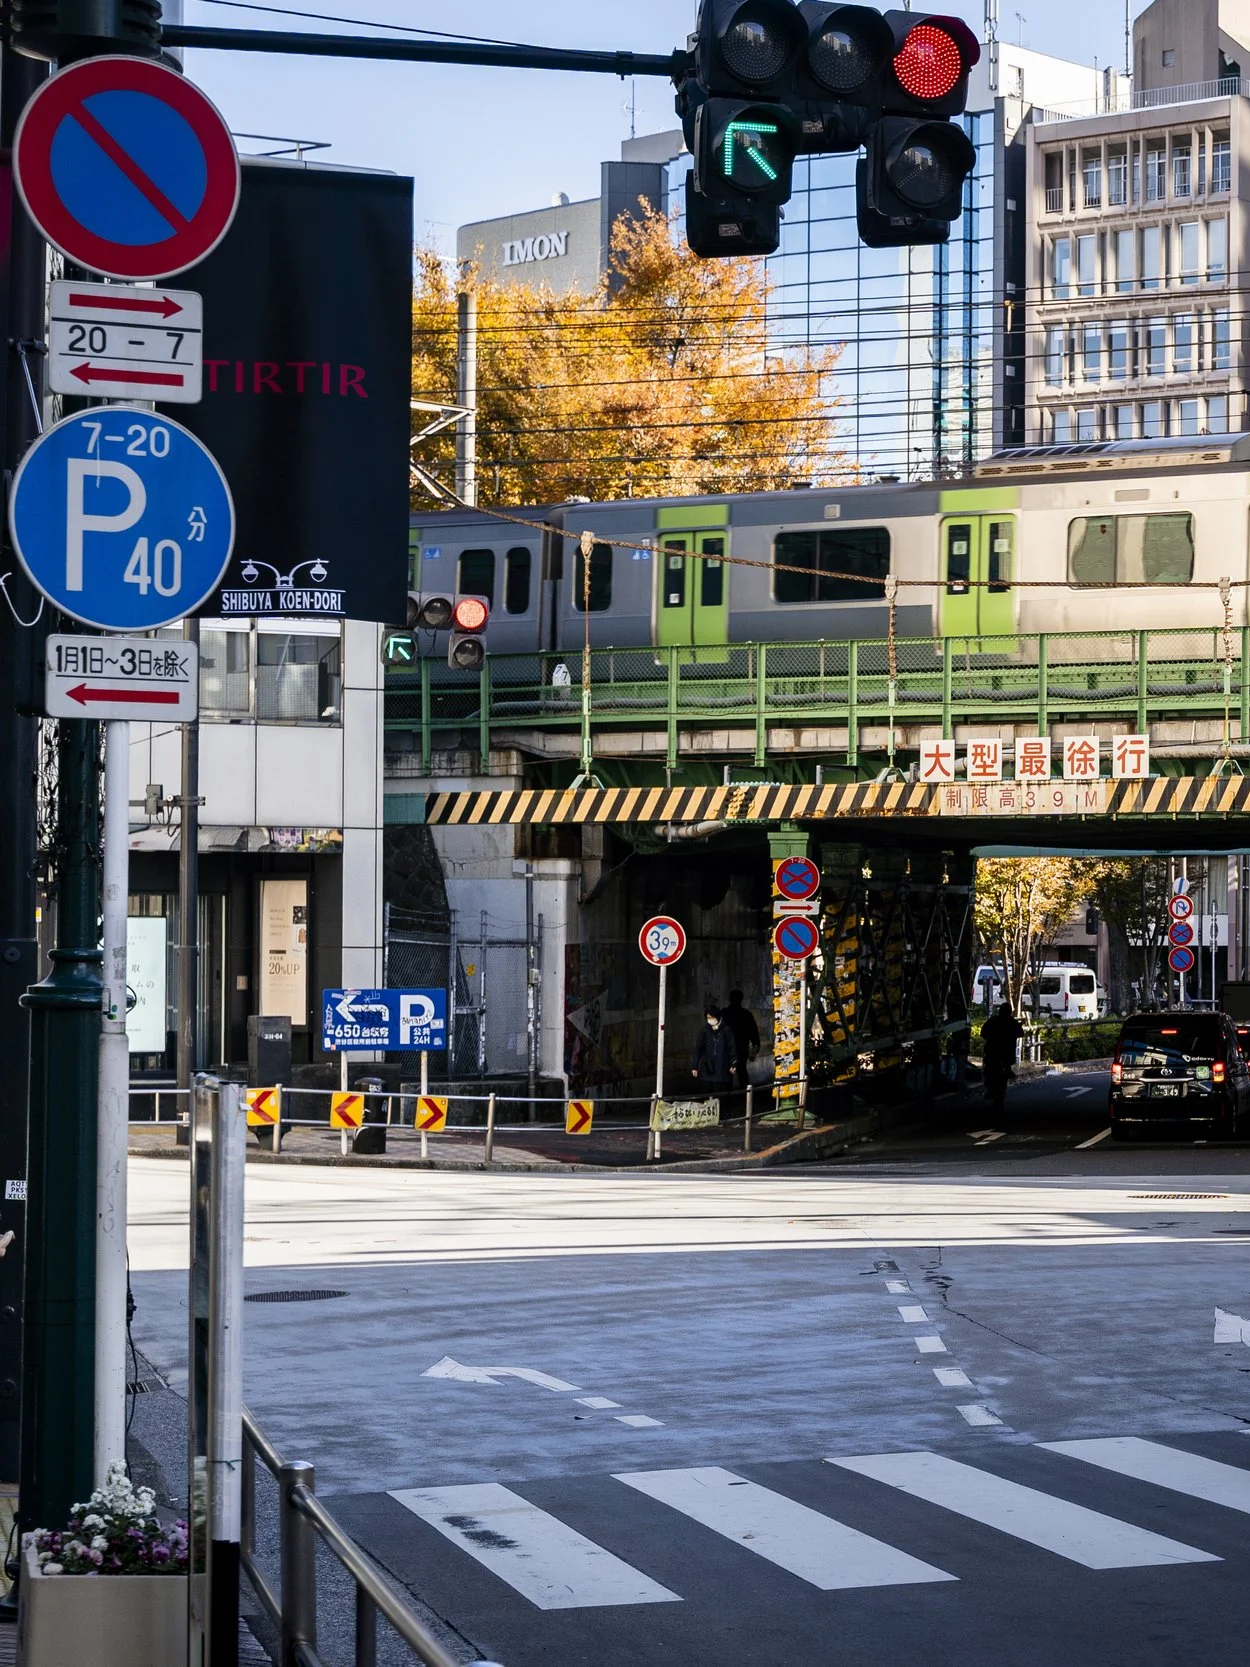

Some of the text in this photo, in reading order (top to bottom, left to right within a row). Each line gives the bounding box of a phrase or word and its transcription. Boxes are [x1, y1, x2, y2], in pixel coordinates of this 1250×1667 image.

[502, 231, 569, 267] IMON
[68, 325, 106, 354] 20
[166, 332, 184, 359] 7
[203, 359, 369, 399] TIRTIR
[81, 421, 171, 458] 7-20
[66, 458, 147, 591] P
[187, 506, 208, 542] 分
[123, 537, 182, 597] 40
[221, 590, 342, 611] SHIBUYA KOEN-DORI
[924, 739, 1146, 778] 大型最徐行
[268, 962, 301, 976] 20%UP
[400, 994, 435, 1045] P
[413, 1027, 431, 1036] 公共
[413, 1036, 431, 1045] 24H
